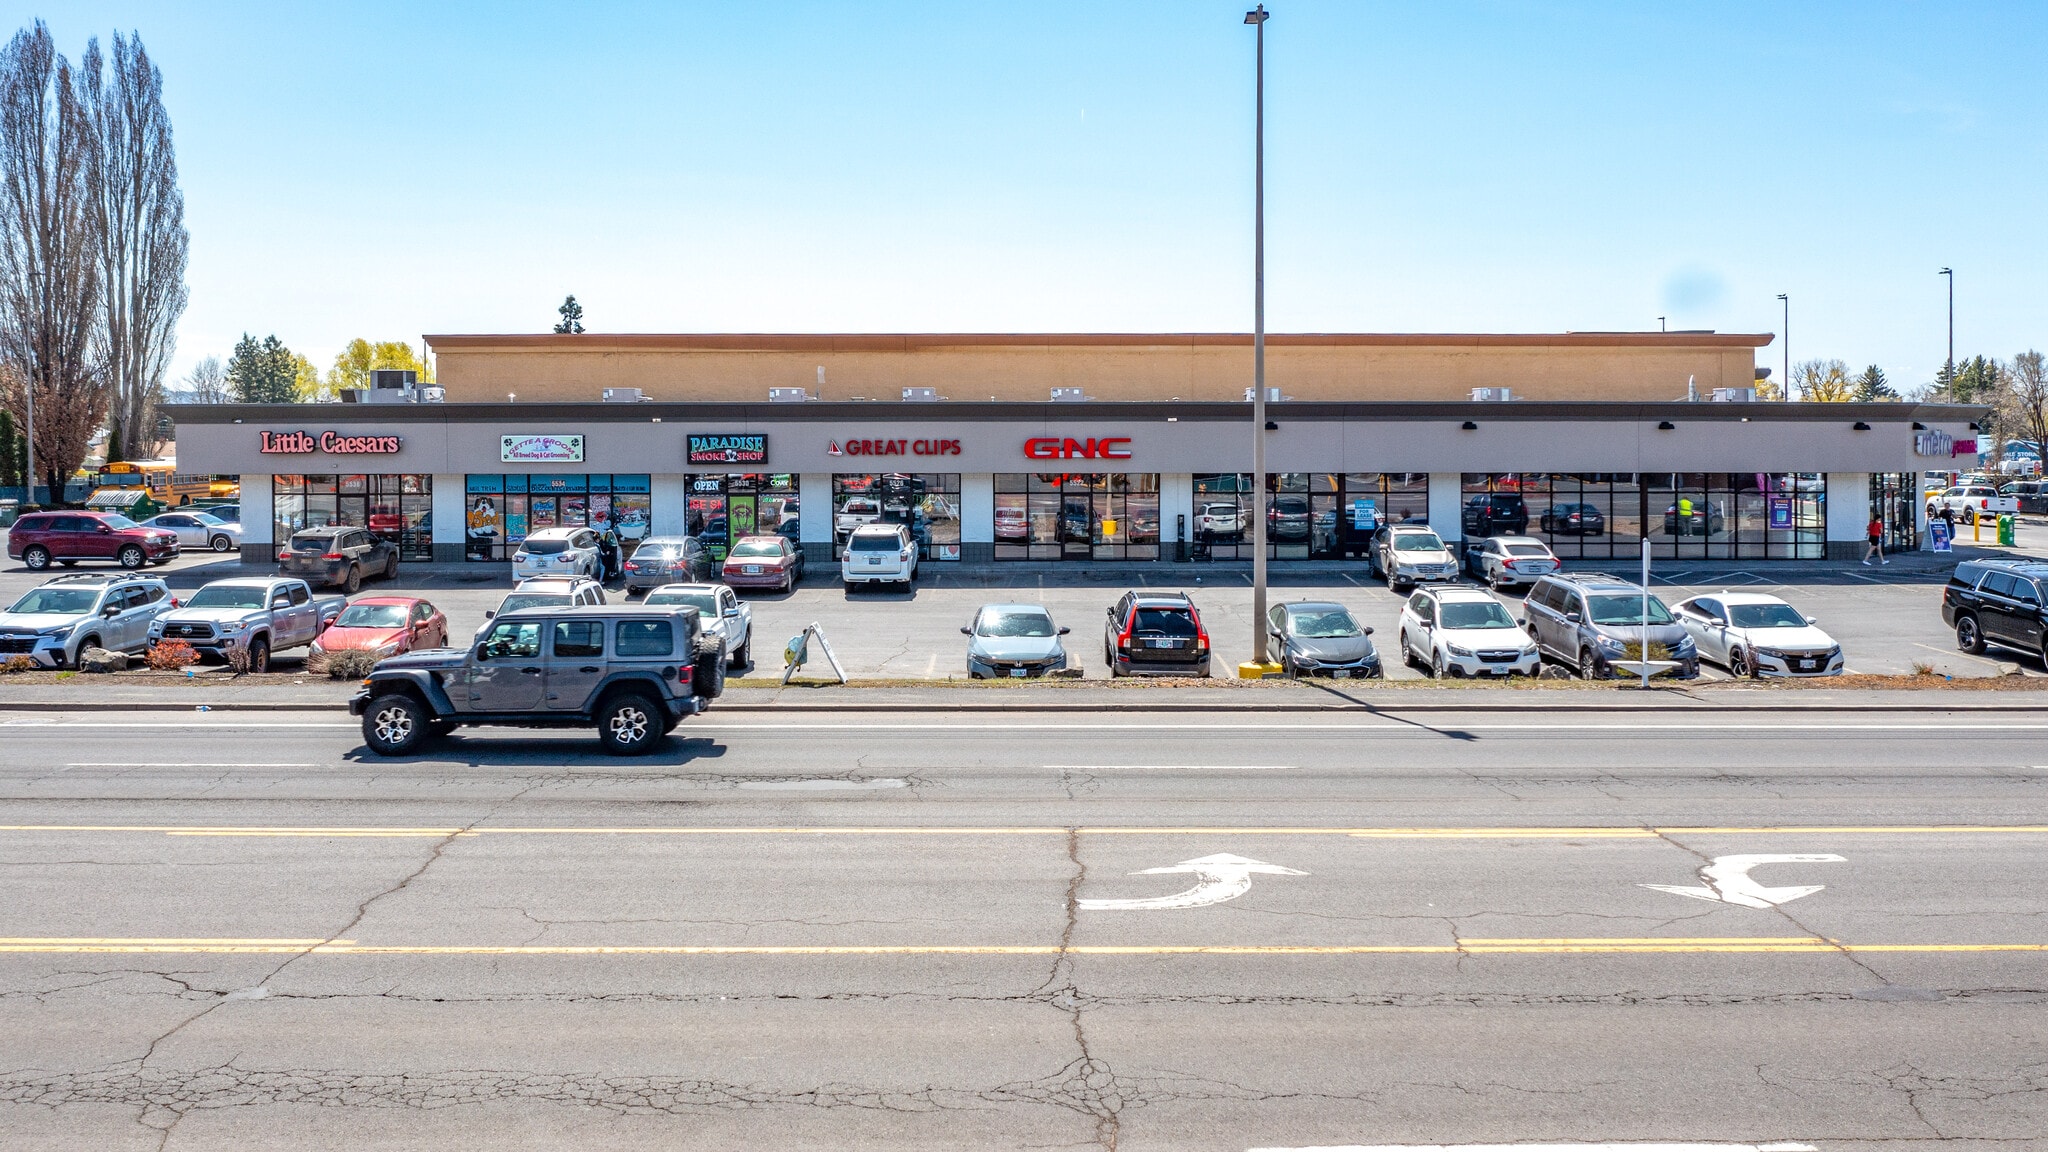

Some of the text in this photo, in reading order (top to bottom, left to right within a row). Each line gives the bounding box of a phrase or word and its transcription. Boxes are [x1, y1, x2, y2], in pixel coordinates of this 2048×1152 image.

[260, 431, 400, 453] Little Caesars
[690, 436, 765, 453] PARADISE
[845, 439, 962, 456] GREAT CLIPS
[1023, 437, 1132, 459] GNC
[691, 452, 765, 461] SMOKE SHOP
[694, 481, 719, 490] OPEN
